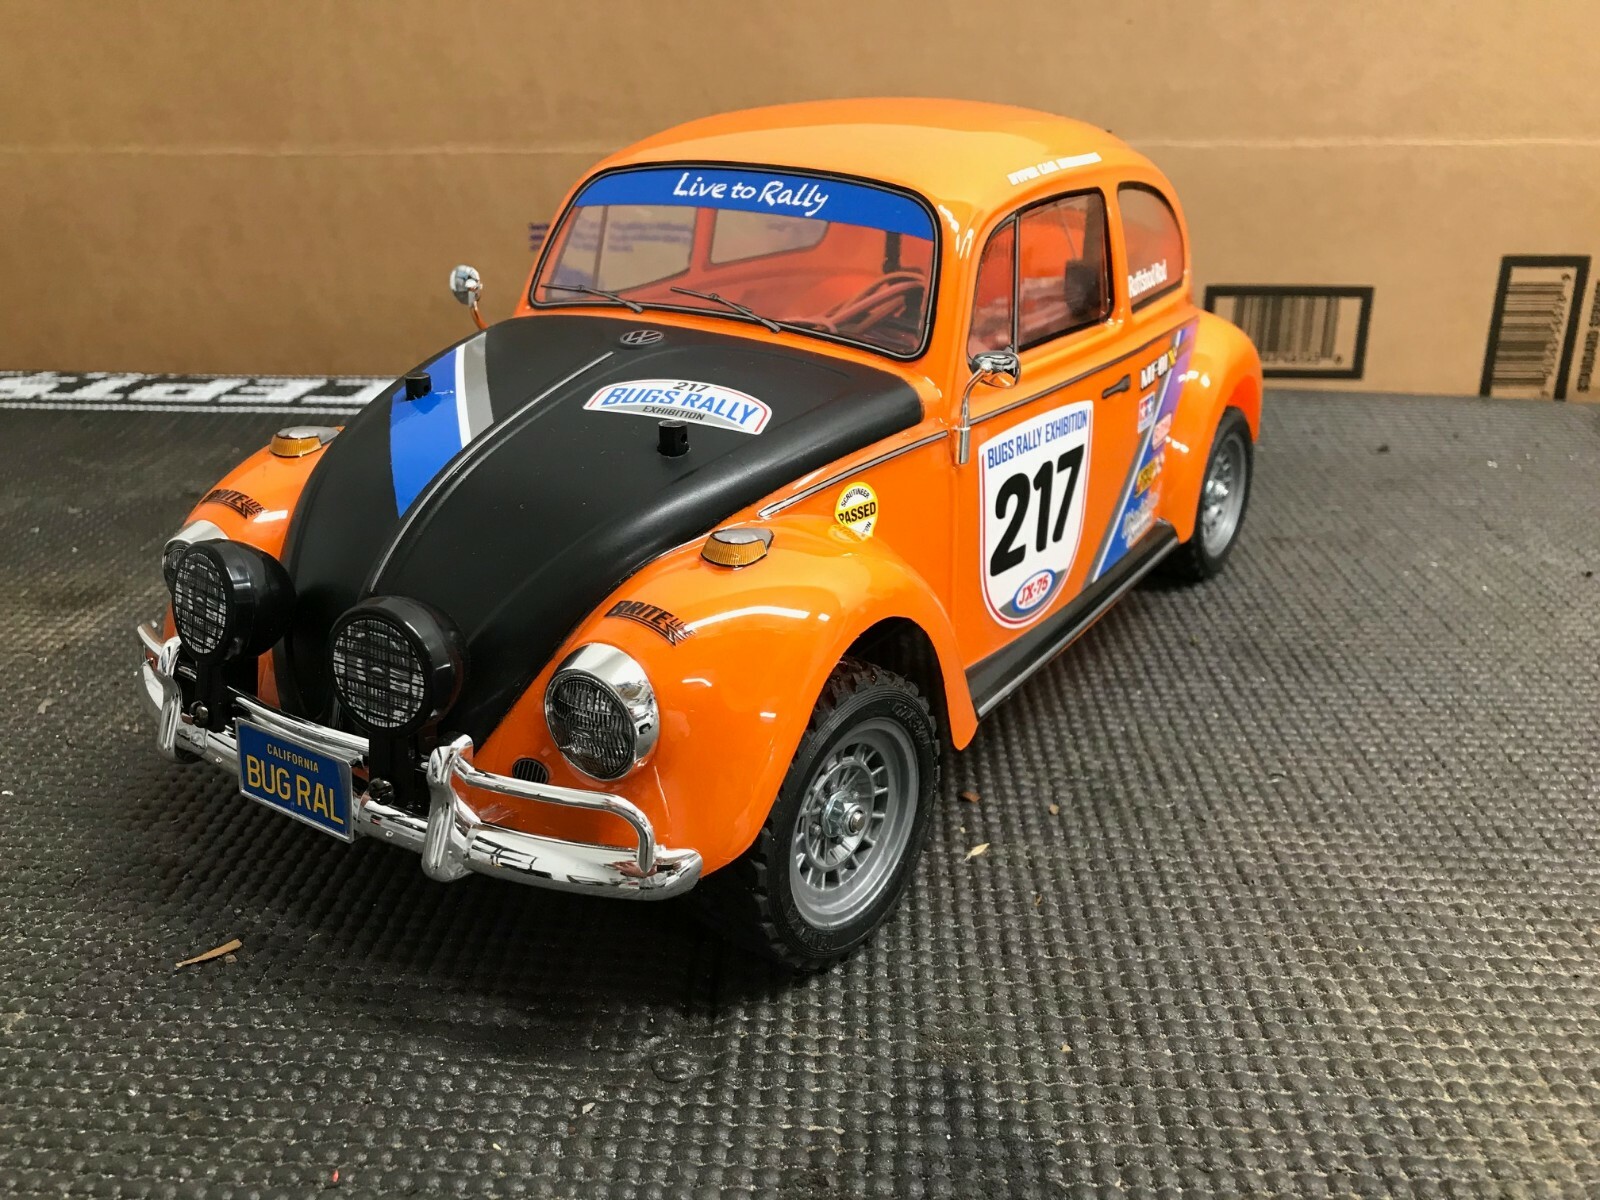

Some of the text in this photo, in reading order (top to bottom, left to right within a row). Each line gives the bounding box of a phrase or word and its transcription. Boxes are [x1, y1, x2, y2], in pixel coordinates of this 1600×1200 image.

[673, 172, 829, 217] Live to Rally
[672, 381, 711, 393] 217
[601, 387, 760, 425] BUGS RALLY
[642, 405, 706, 421] EXHIBITION
[987, 408, 1088, 469] BUGS RALLY EXHIBITION
[838, 501, 877, 525] PASSED
[841, 487, 871, 507] SCRUTINEER
[990, 443, 1085, 577] 217
[266, 743, 319, 774] CALIFORNIA
[246, 754, 344, 825] BUG RAL
